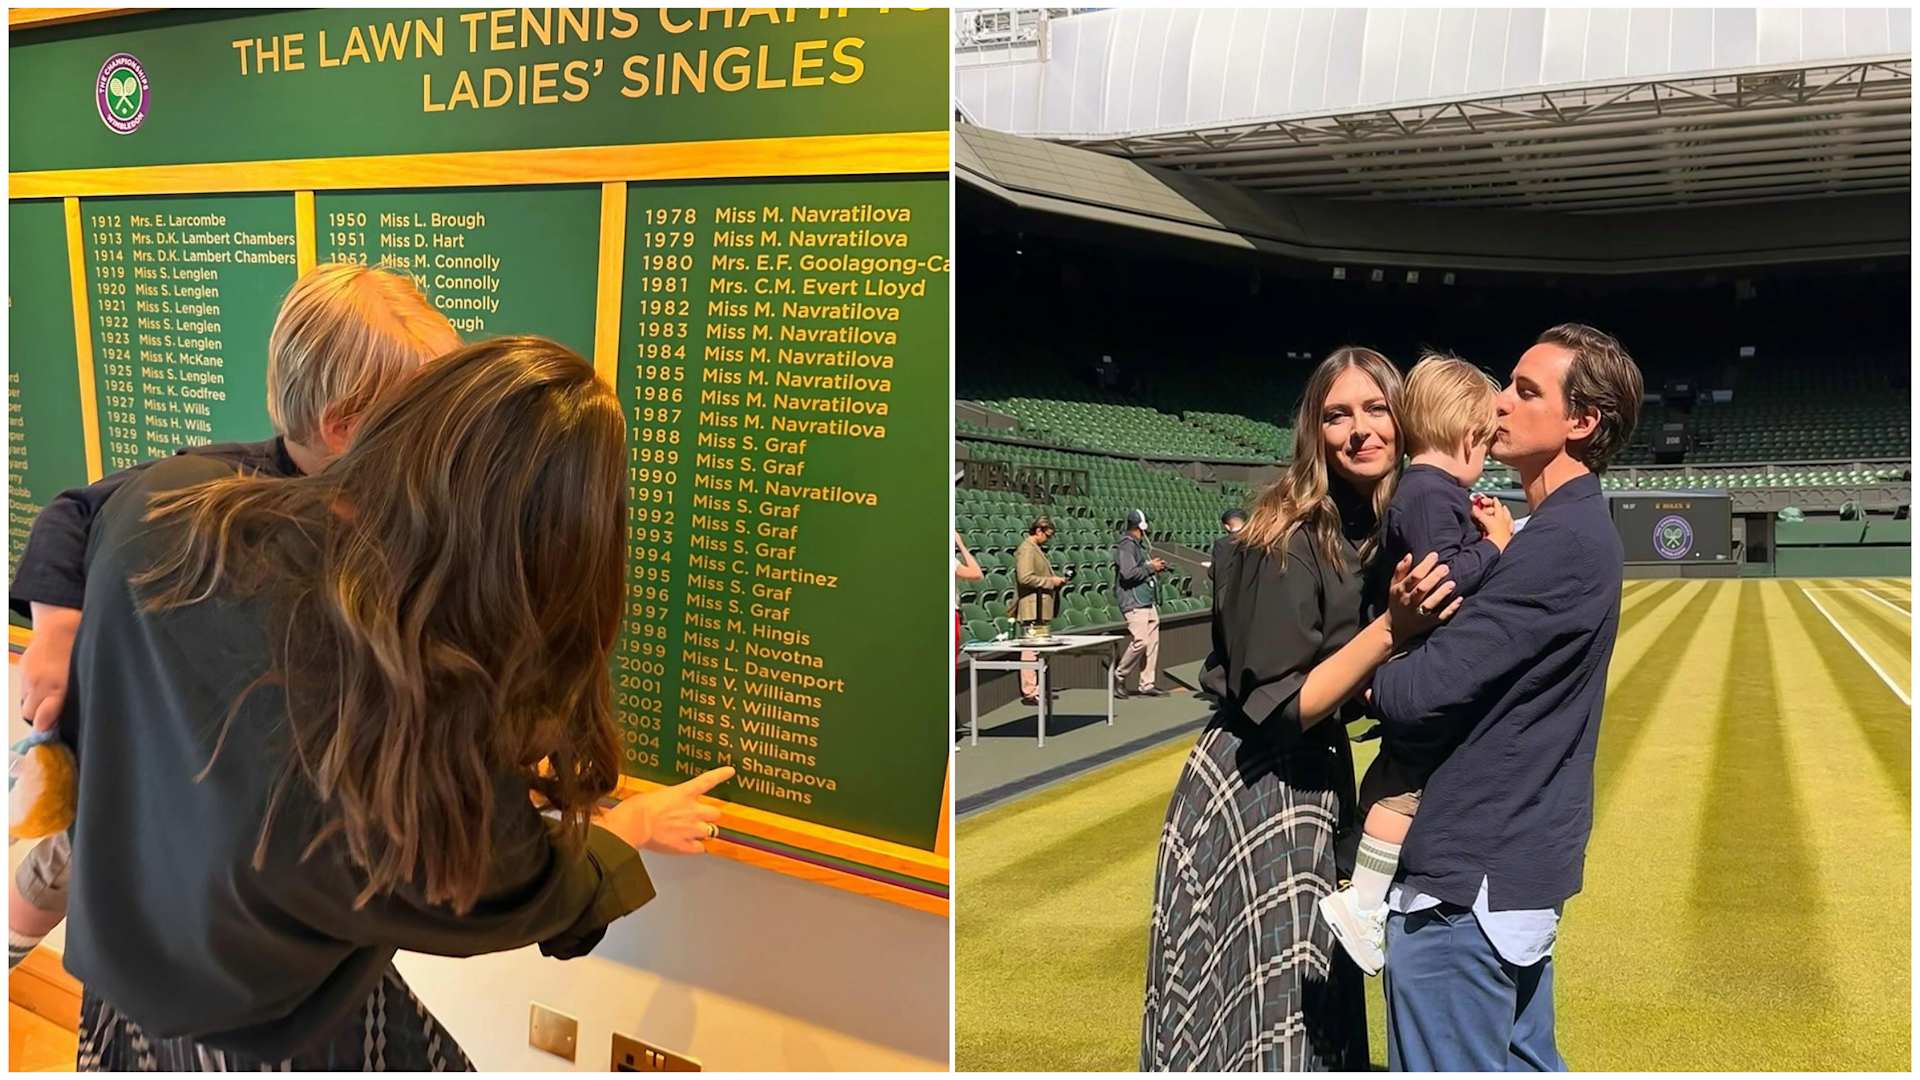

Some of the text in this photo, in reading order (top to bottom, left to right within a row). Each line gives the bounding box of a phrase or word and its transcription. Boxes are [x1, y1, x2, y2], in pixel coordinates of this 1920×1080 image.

[232, 33, 305, 75] THE
[319, 17, 444, 67] LAWN
[460, 8, 640, 53] TENNIS
[620, 37, 865, 98] SINGLES
[99, 75, 107, 94] THE
[92, 213, 226, 228] 1912 Mrs. E. Larcombe
[329, 212, 485, 230] 1950 Miss L. Brough
[646, 205, 910, 225] 1978 Miss M. Navratilova
[93, 231, 295, 245] 1913 Mrs. D.K. Lambert Chambers
[330, 232, 464, 248] 1951 Miss D. Hart
[645, 230, 907, 248] 1979 Miss M. Navratilova
[94, 249, 296, 264] 1914 Mrs. D.K. Lambert Chambers
[331, 252, 500, 271] 1952 Miss M. Connolly
[643, 255, 693, 271] 1980
[712, 255, 749, 270] Mrs.
[757, 254, 792, 270] E.F.
[96, 266, 218, 282] 1919 Miss S. Lenglen
[415, 274, 500, 292] M. Connolly
[97, 283, 219, 299] 1920 Miss S. Lenglen
[642, 277, 926, 299] 1981 Mrs. C.M. Evert Lloyd
[435, 295, 500, 313] Connolly
[640, 300, 899, 321] 1982 Miss M. Navratilova
[100, 316, 221, 334] 1922 Miss S. Lenglen
[448, 316, 485, 332] ough
[102, 348, 223, 367] 1924 Miss K. McKane
[638, 344, 894, 368] 1984 Miss M. Navratilova
[104, 364, 224, 385] 1925 Miss S. Lenglen
[636, 365, 891, 392] 1985 Miss M. Navratilova
[105, 380, 226, 401] 1926 Mrs. K. Godfree
[107, 411, 212, 432] 1928 Miss H. Wills
[634, 407, 885, 438] 1987 Miss M. Navratilova
[111, 441, 138, 455] 1930
[633, 427, 807, 454] 1988 Miss S. Graf
[631, 467, 877, 506] 1990 Miss M. Navratilova
[629, 487, 800, 519] 1991 Miss S. Graf
[627, 526, 796, 560] 1993 Miss S. Graf
[628, 545, 838, 588] 1994 Miss C. Martinez
[625, 601, 810, 645] 1997 Miss M. Hingis
[623, 620, 823, 668] 1998 Miss J. Novotna
[622, 638, 844, 693] 1999 Miss L. Davenport
[621, 656, 821, 708] 2000 Miss V. Williams
[679, 705, 714, 724] Miss
[720, 714, 735, 729] S.
[741, 718, 818, 747] Williams
[678, 724, 712, 742] Miss
[719, 733, 733, 748] S.
[740, 737, 816, 766] Williams
[677, 741, 837, 791] Miss M. Sharapova
[736, 774, 813, 805] Williams
